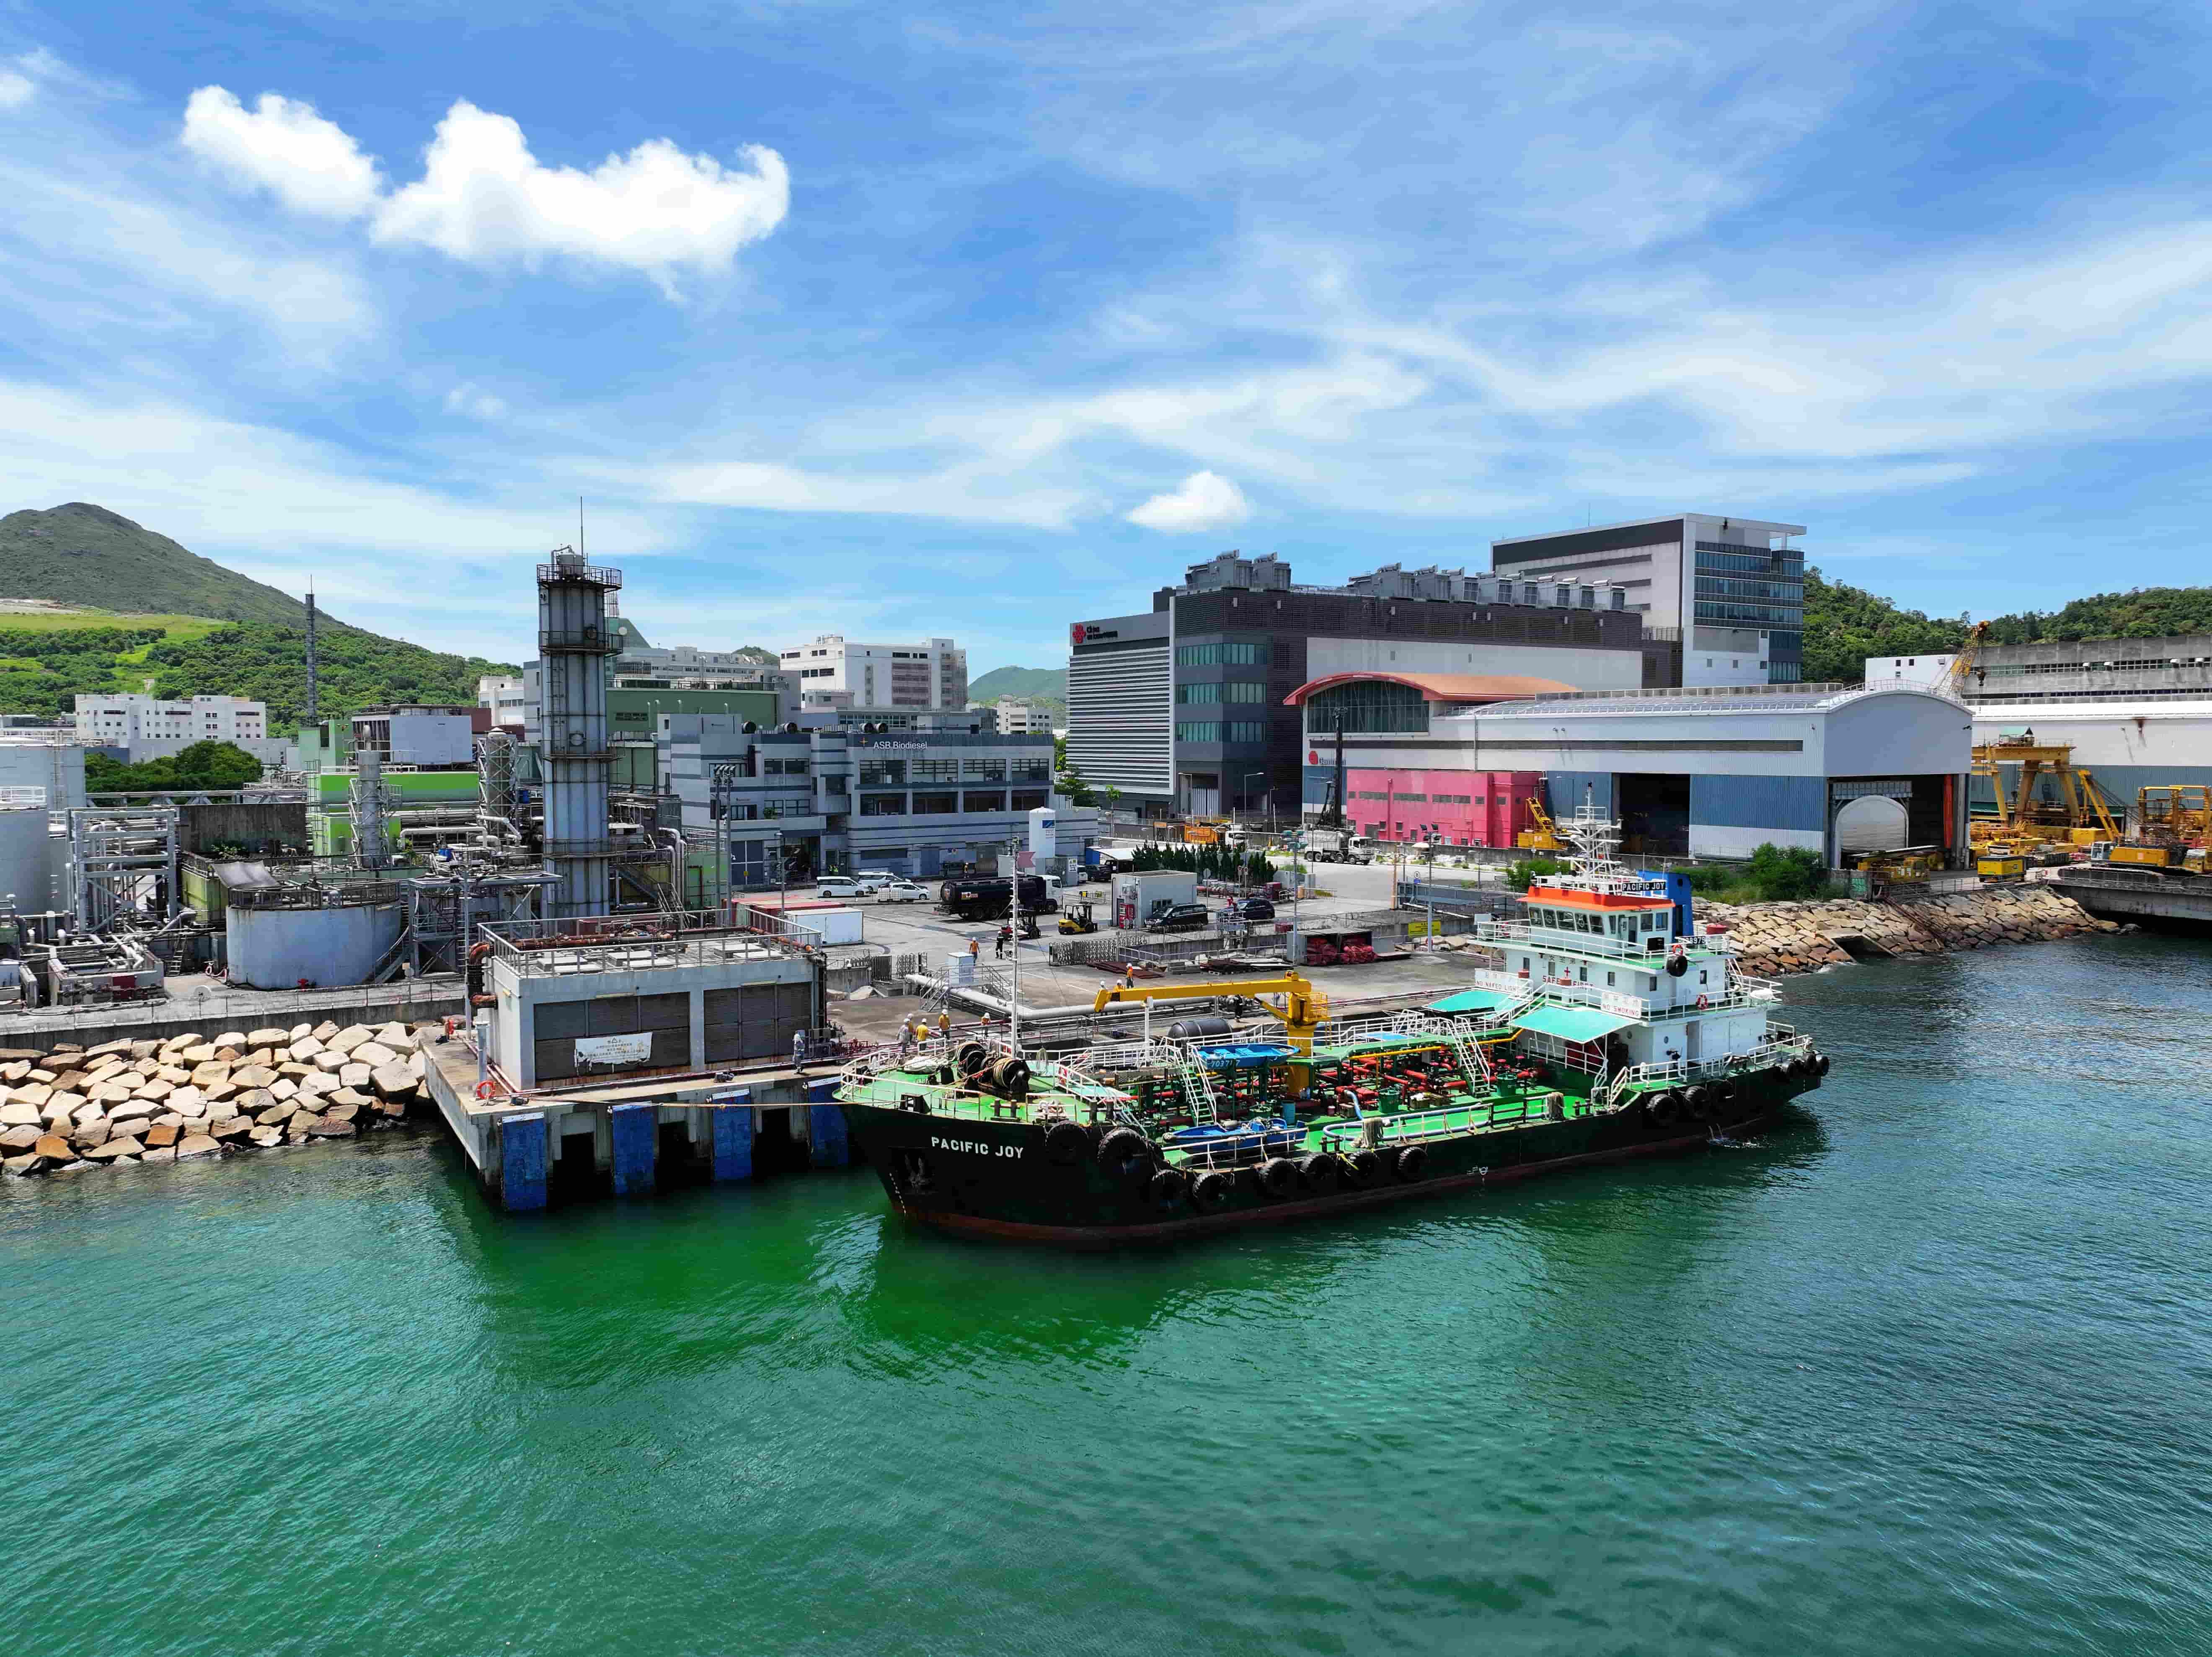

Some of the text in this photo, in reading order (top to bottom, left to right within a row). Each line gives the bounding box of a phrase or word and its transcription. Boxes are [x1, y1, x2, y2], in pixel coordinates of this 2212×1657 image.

[874, 741, 927, 750] ASB Biodiesel
[1622, 882, 1665, 891] PACIFIC JOY
[1542, 975, 1561, 985] SAFE
[1613, 1005, 1640, 1016] SMOKING
[931, 1136, 1023, 1159] PACIFIC JOY
